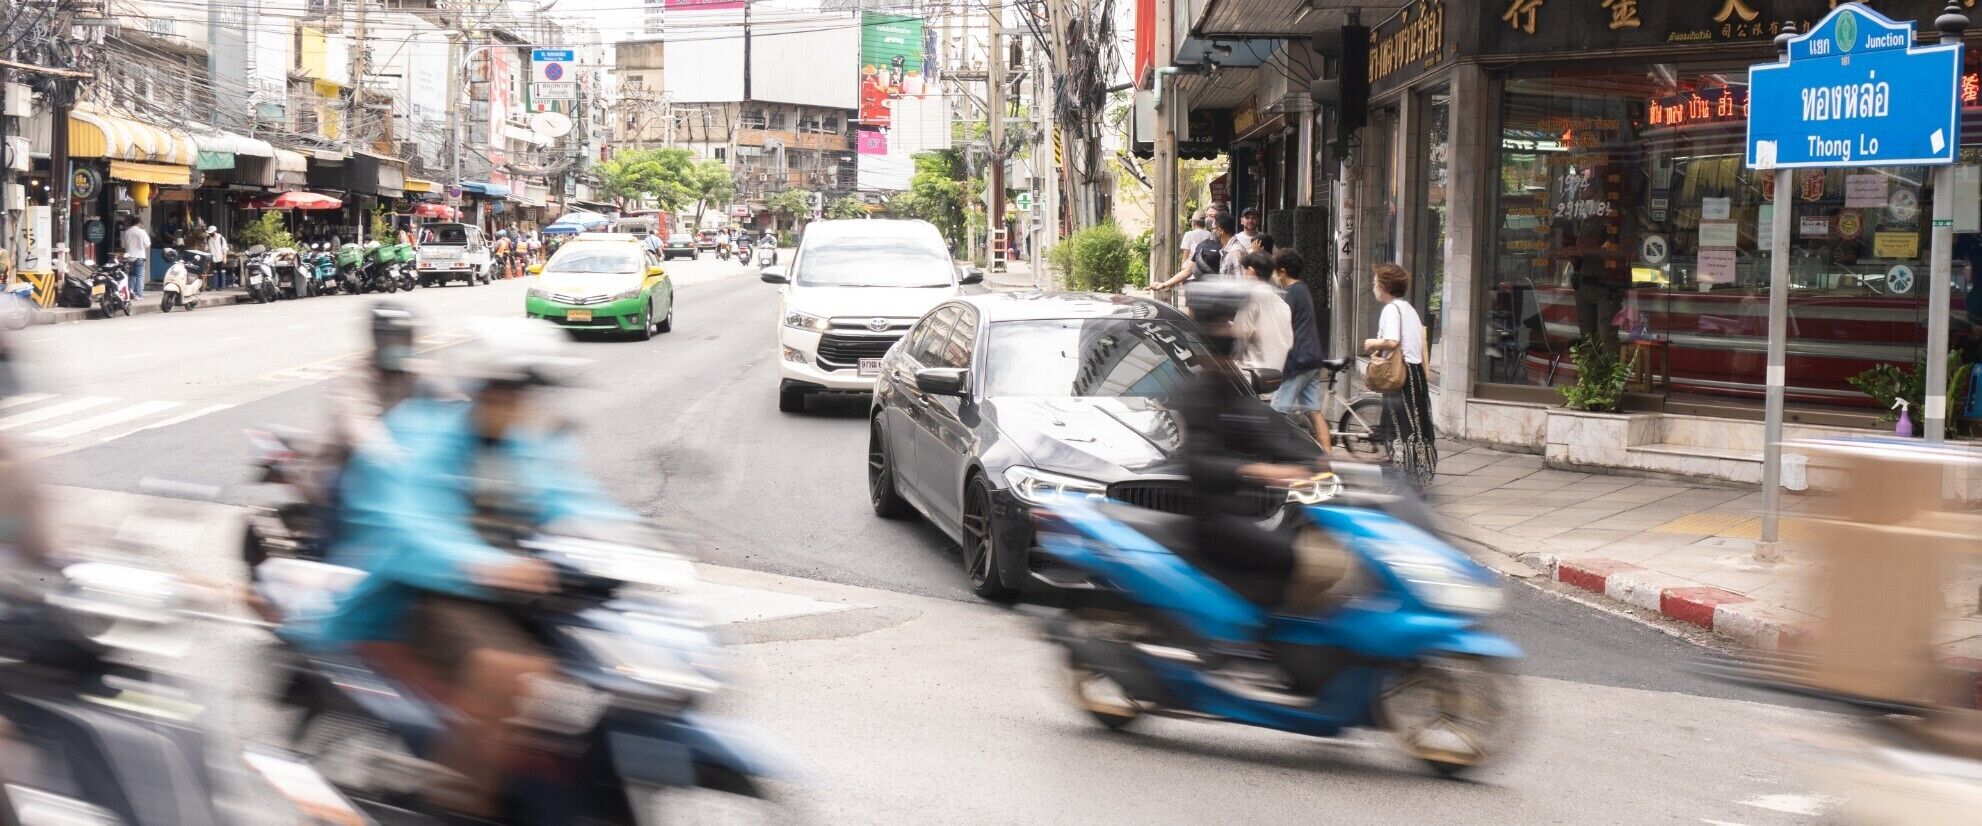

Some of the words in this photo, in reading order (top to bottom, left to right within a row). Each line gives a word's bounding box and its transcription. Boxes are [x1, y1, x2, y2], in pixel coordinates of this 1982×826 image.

[1809, 38, 1830, 55] แยก
[1865, 33, 1904, 49] Junction
[1801, 69, 1890, 121] ทองหล่อ
[1807, 135, 1851, 162] Thong
[1859, 133, 1879, 155] Lo
[1341, 240, 1351, 256] 4
